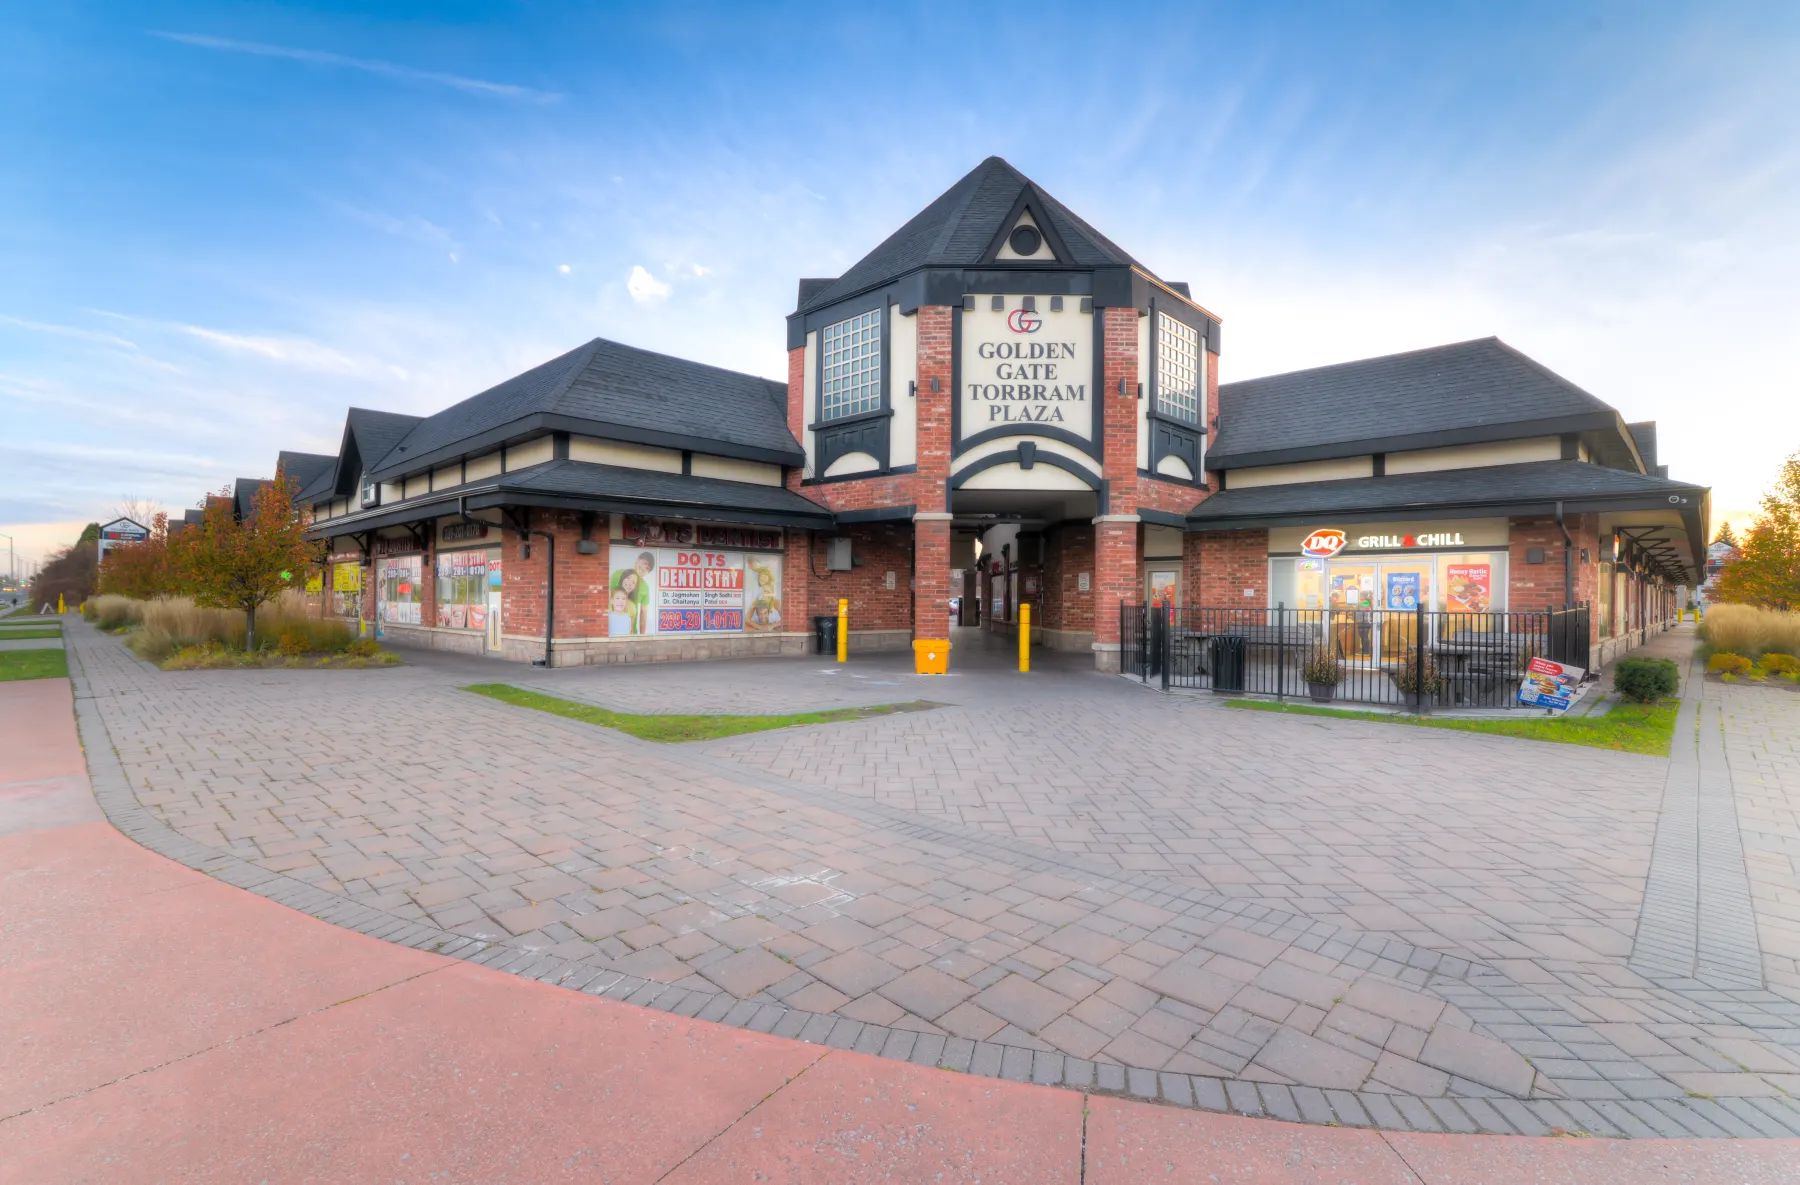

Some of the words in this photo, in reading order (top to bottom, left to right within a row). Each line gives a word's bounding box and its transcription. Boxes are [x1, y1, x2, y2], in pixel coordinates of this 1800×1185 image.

[978, 342, 1076, 359] GOLDEN
[995, 362, 1058, 381] GATE
[968, 384, 1085, 401] TORBRAM
[988, 404, 1064, 421] PLAZA
[697, 527, 781, 548] DENTIST
[1309, 535, 1339, 551] DQ
[1358, 535, 1401, 548] GRILL
[1402, 534, 1415, 547] &
[1417, 533, 1464, 546] CHILL
[660, 568, 738, 588] DENTISTRY
